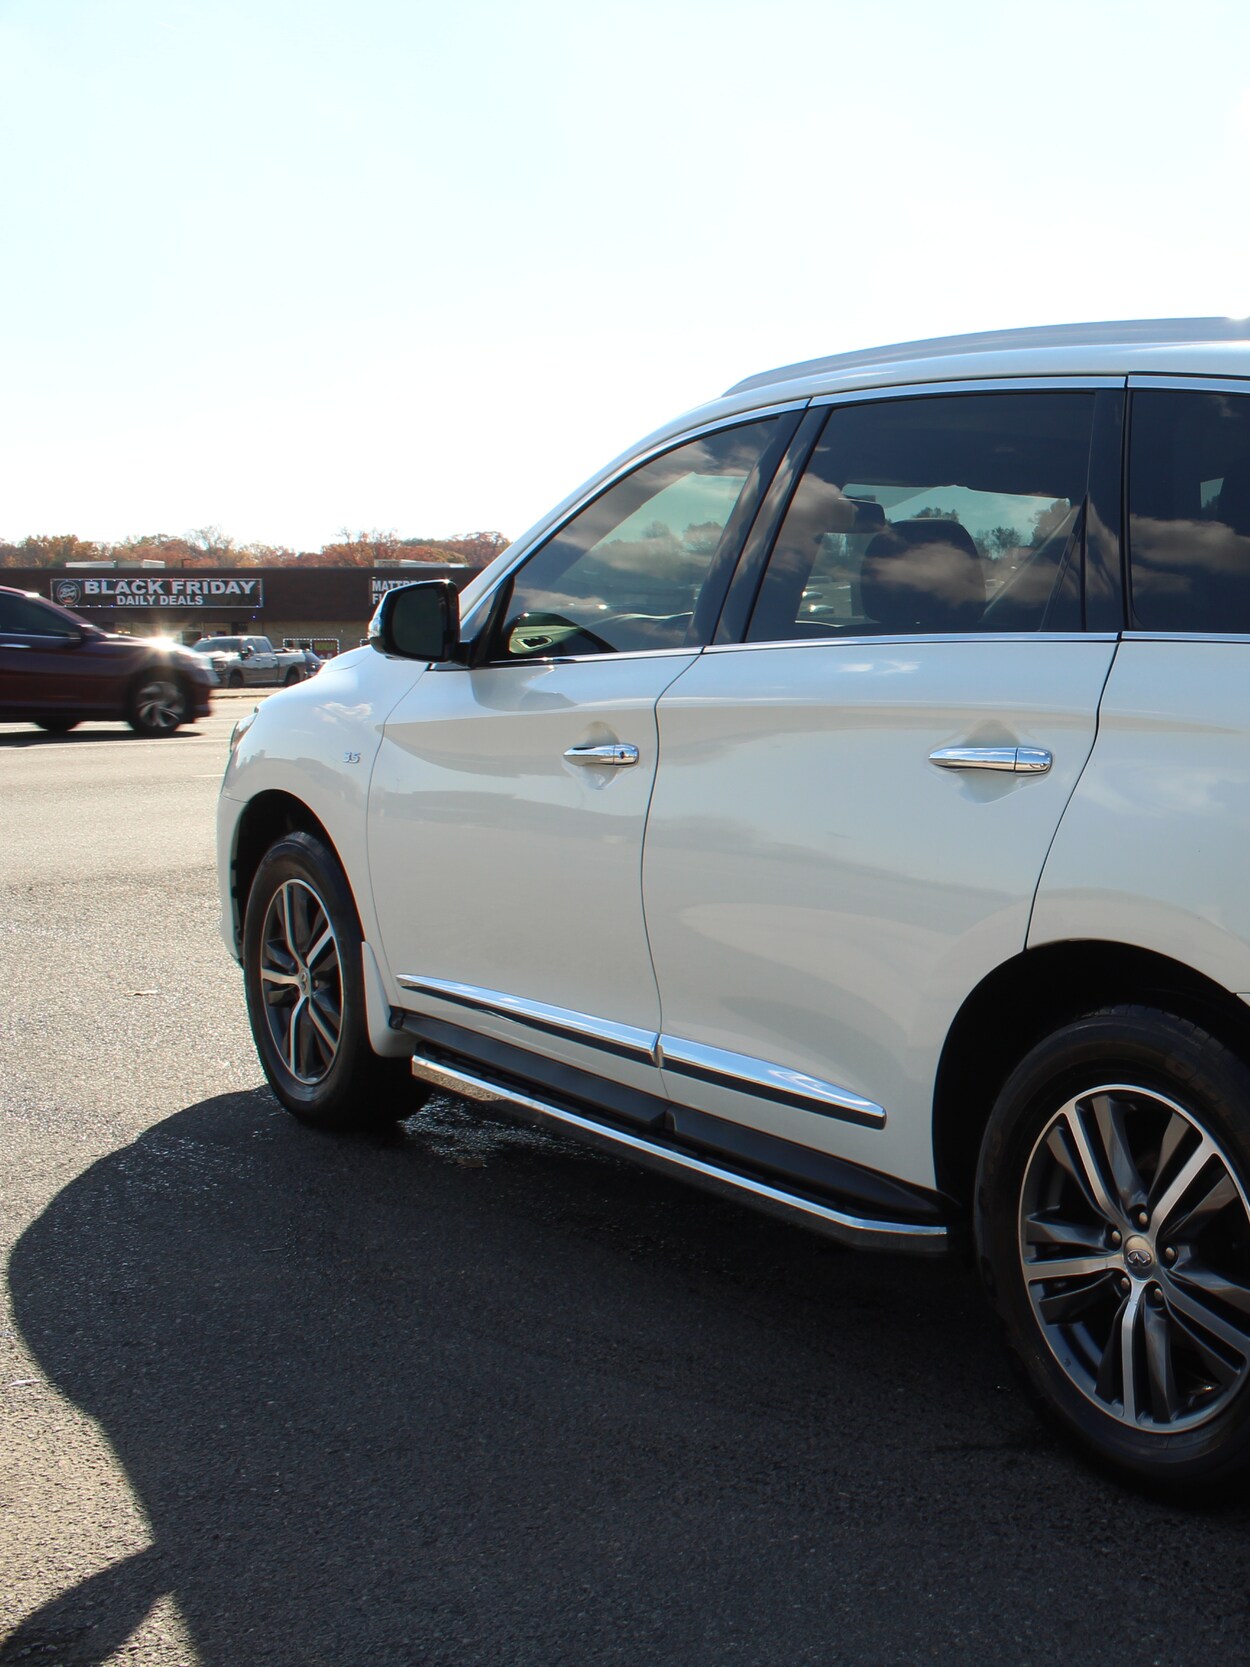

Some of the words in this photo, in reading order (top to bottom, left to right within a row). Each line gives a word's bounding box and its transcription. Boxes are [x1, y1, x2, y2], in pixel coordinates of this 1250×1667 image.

[84, 580, 164, 595] BLACK
[171, 580, 256, 595] FRIDAY
[116, 595, 155, 606] DAILY
[159, 595, 204, 606] DEALS
